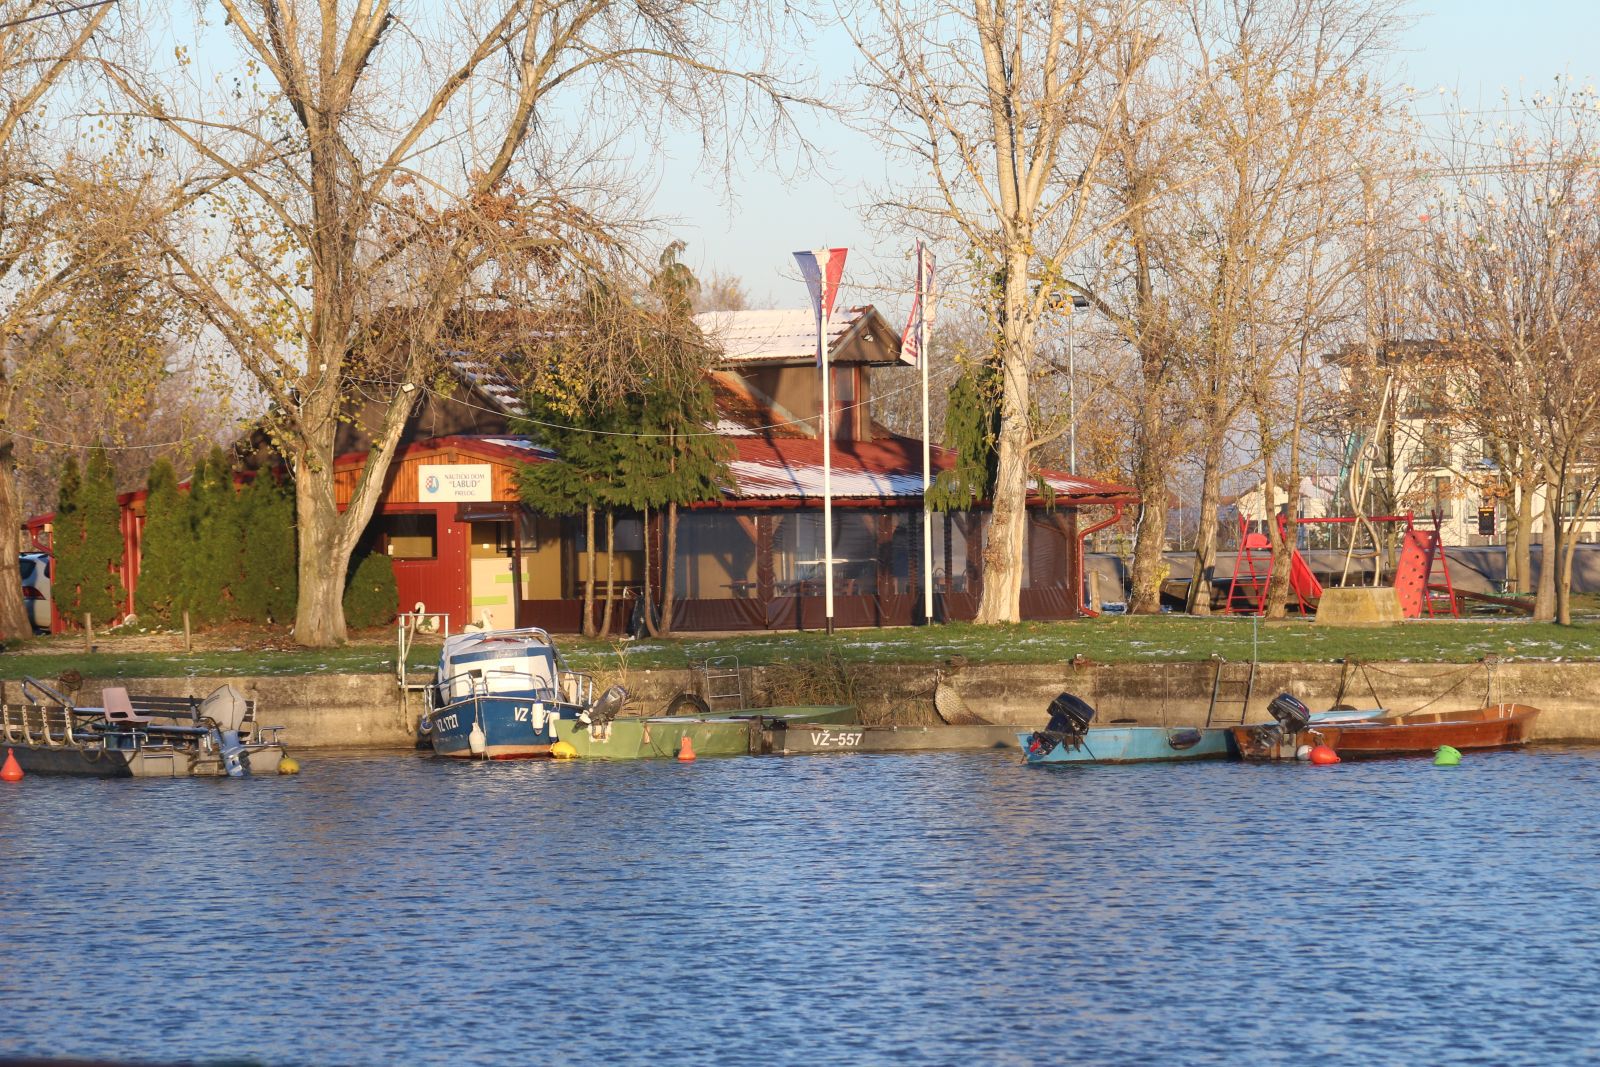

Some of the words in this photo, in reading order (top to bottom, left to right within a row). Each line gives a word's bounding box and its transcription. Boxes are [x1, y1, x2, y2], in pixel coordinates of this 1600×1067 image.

[443, 713, 459, 730] 1727
[514, 706, 529, 722] VZ
[811, 730, 863, 746] VŽ-557
